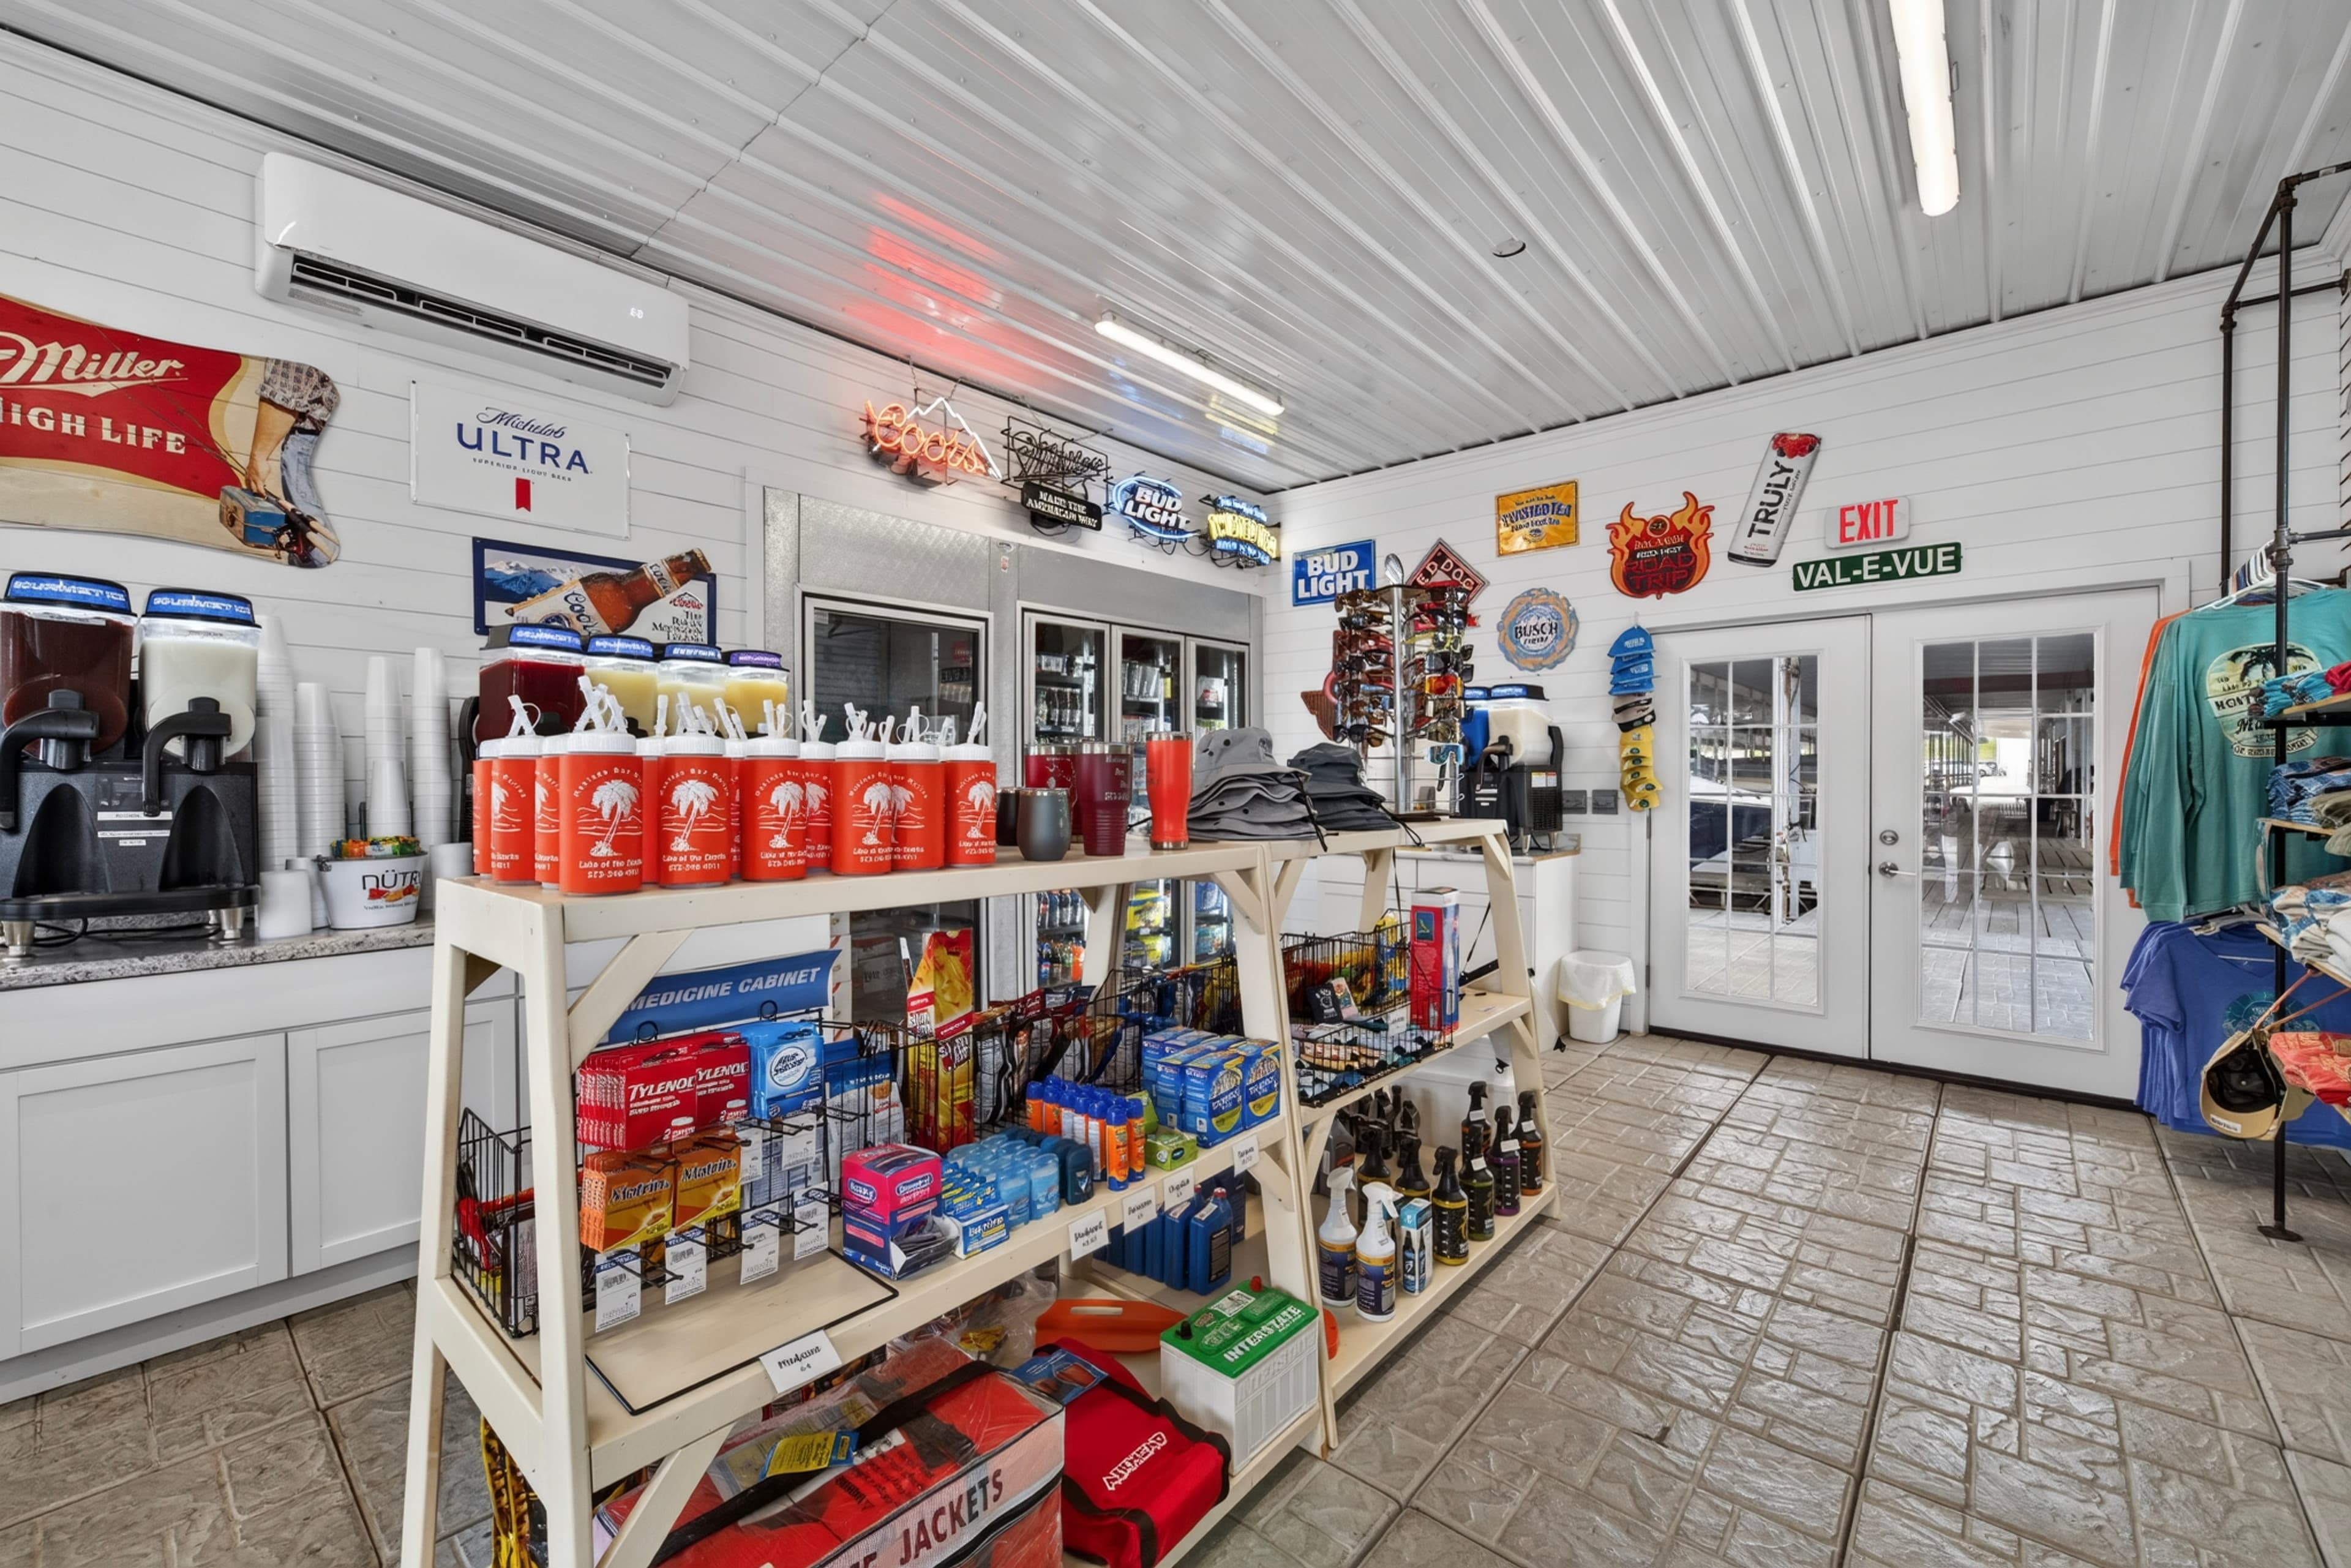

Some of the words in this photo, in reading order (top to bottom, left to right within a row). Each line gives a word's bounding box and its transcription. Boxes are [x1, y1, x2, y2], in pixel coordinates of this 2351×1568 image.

[101, 416, 186, 455] LIFE
[476, 407, 568, 439] Michelob
[864, 400, 987, 476] Coors
[457, 422, 590, 475] ULTRA
[1124, 500, 1191, 530] LIGHT
[1135, 486, 1183, 512] BUD
[1747, 460, 1794, 538] TRULY
[1839, 499, 1899, 544] EXIT
[1307, 550, 1359, 577] BUD
[1415, 561, 1439, 587] ED
[1624, 552, 1697, 574] ROAD
[1629, 569, 1689, 590] TRIP
[1796, 546, 1957, 588] VAL-E-VUE
[1297, 569, 1370, 599] LIGHT
[1514, 618, 1558, 640] BUSCH
[628, 981, 733, 1010] MEDICINE
[738, 967, 821, 994] CABINET
[1223, 1304, 1303, 1363] INTERSTATE
[1102, 1431, 1168, 1491] AIRHEAD
[899, 1468, 1003, 1566] JACKETS
